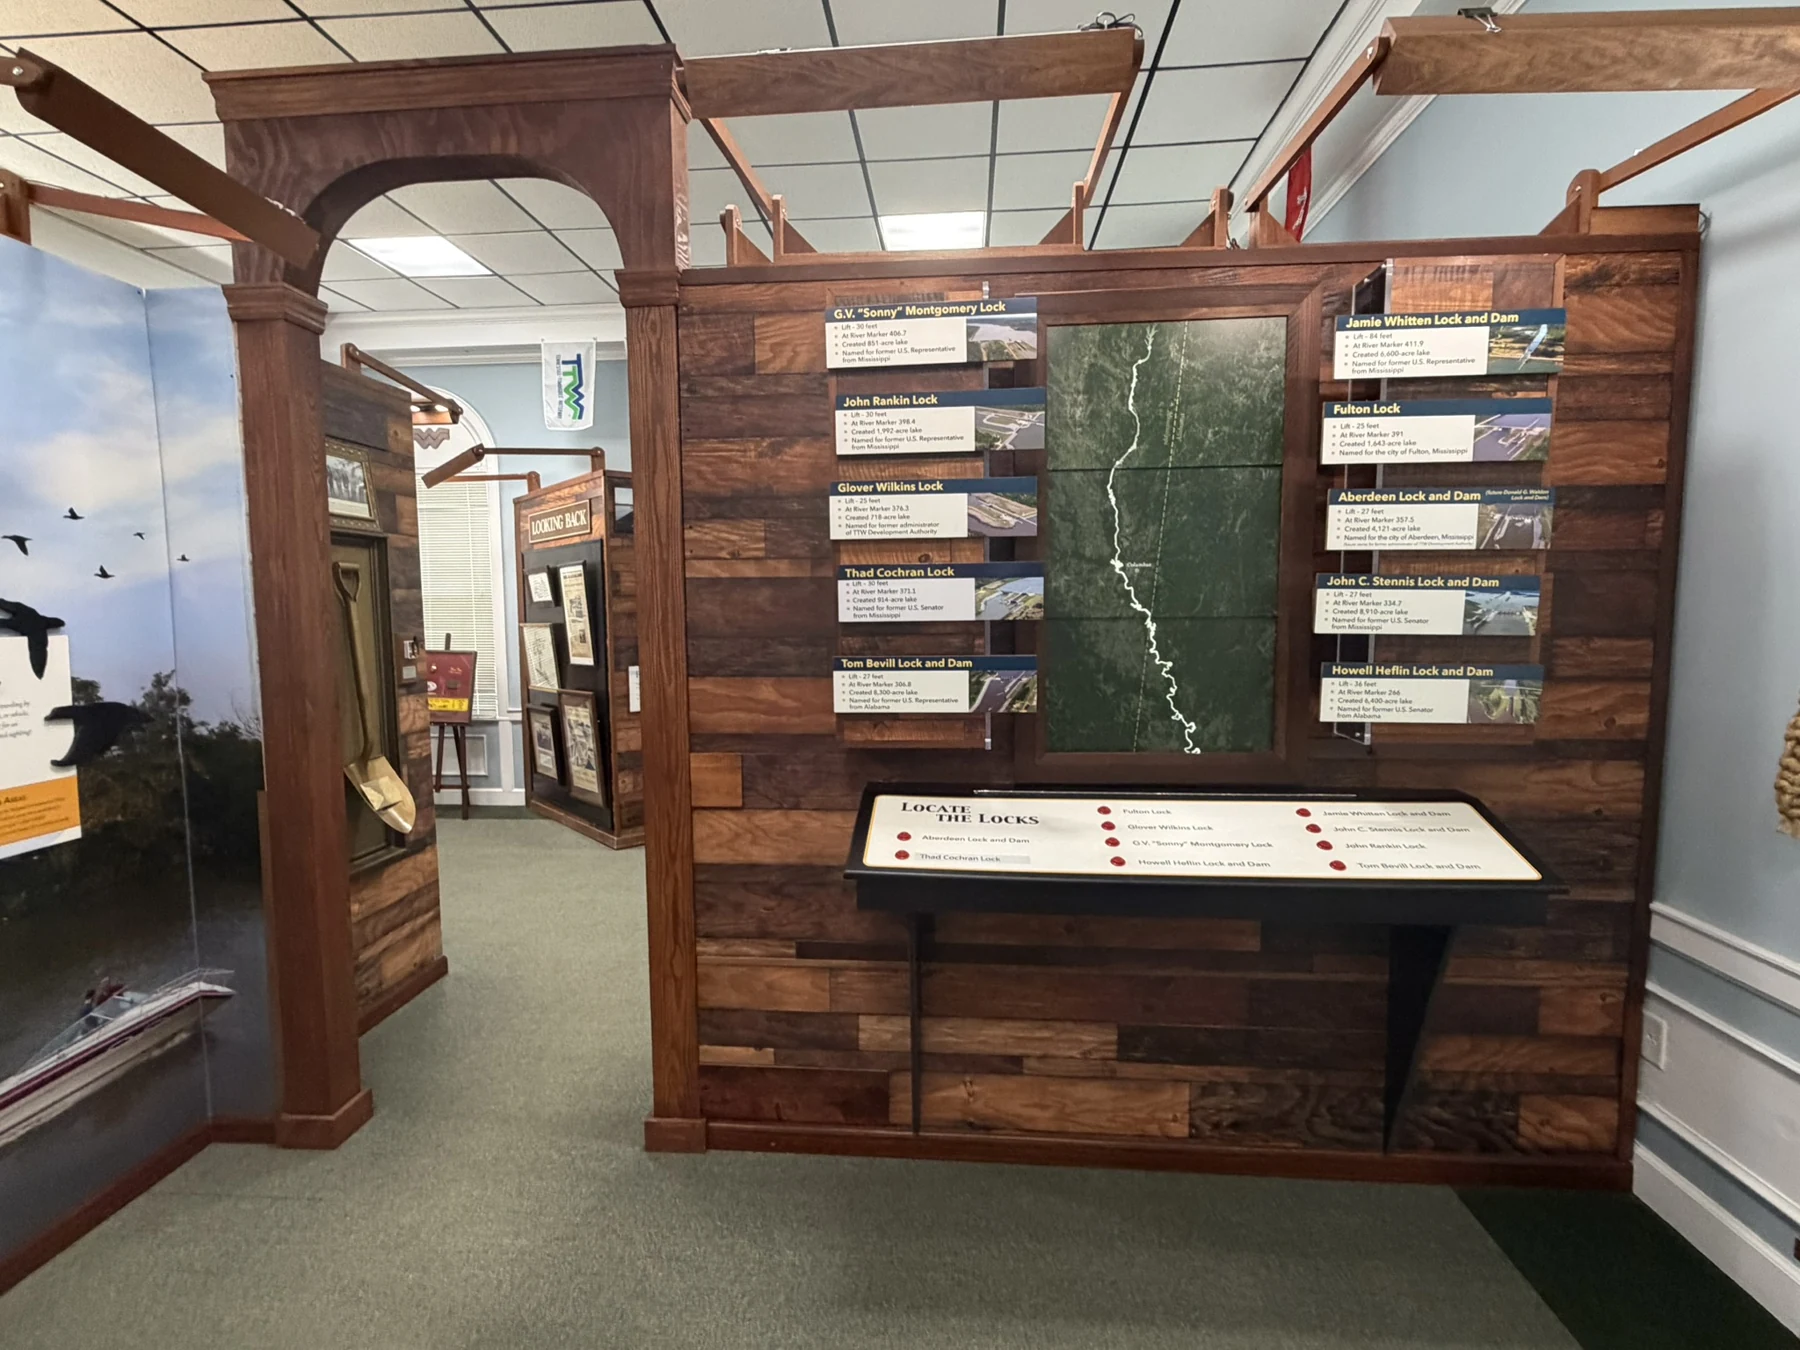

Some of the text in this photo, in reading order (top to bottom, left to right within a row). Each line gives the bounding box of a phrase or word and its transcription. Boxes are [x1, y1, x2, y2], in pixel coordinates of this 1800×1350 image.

[834, 309, 855, 319] G.V.
[906, 304, 977, 317] Montgomery
[980, 302, 1005, 312] Lock
[1346, 313, 1519, 328] Jamie Whitten Lock and Dam
[844, 394, 938, 407] John Rankin Lock
[1334, 403, 1400, 415] Fulton Lock
[838, 481, 943, 493] Glover Wilkins Lock
[1338, 491, 1481, 502] Aberdeen Lock and Dam
[532, 509, 587, 535] LOOKING BACK
[845, 566, 955, 578] Thad Cochran Lock
[1327, 576, 1499, 587] John C. Stennis Lock and Dam
[841, 659, 972, 668] Tom Bevill Lock and Dam
[1332, 666, 1493, 676] Howell Heflin Lock and Dam
